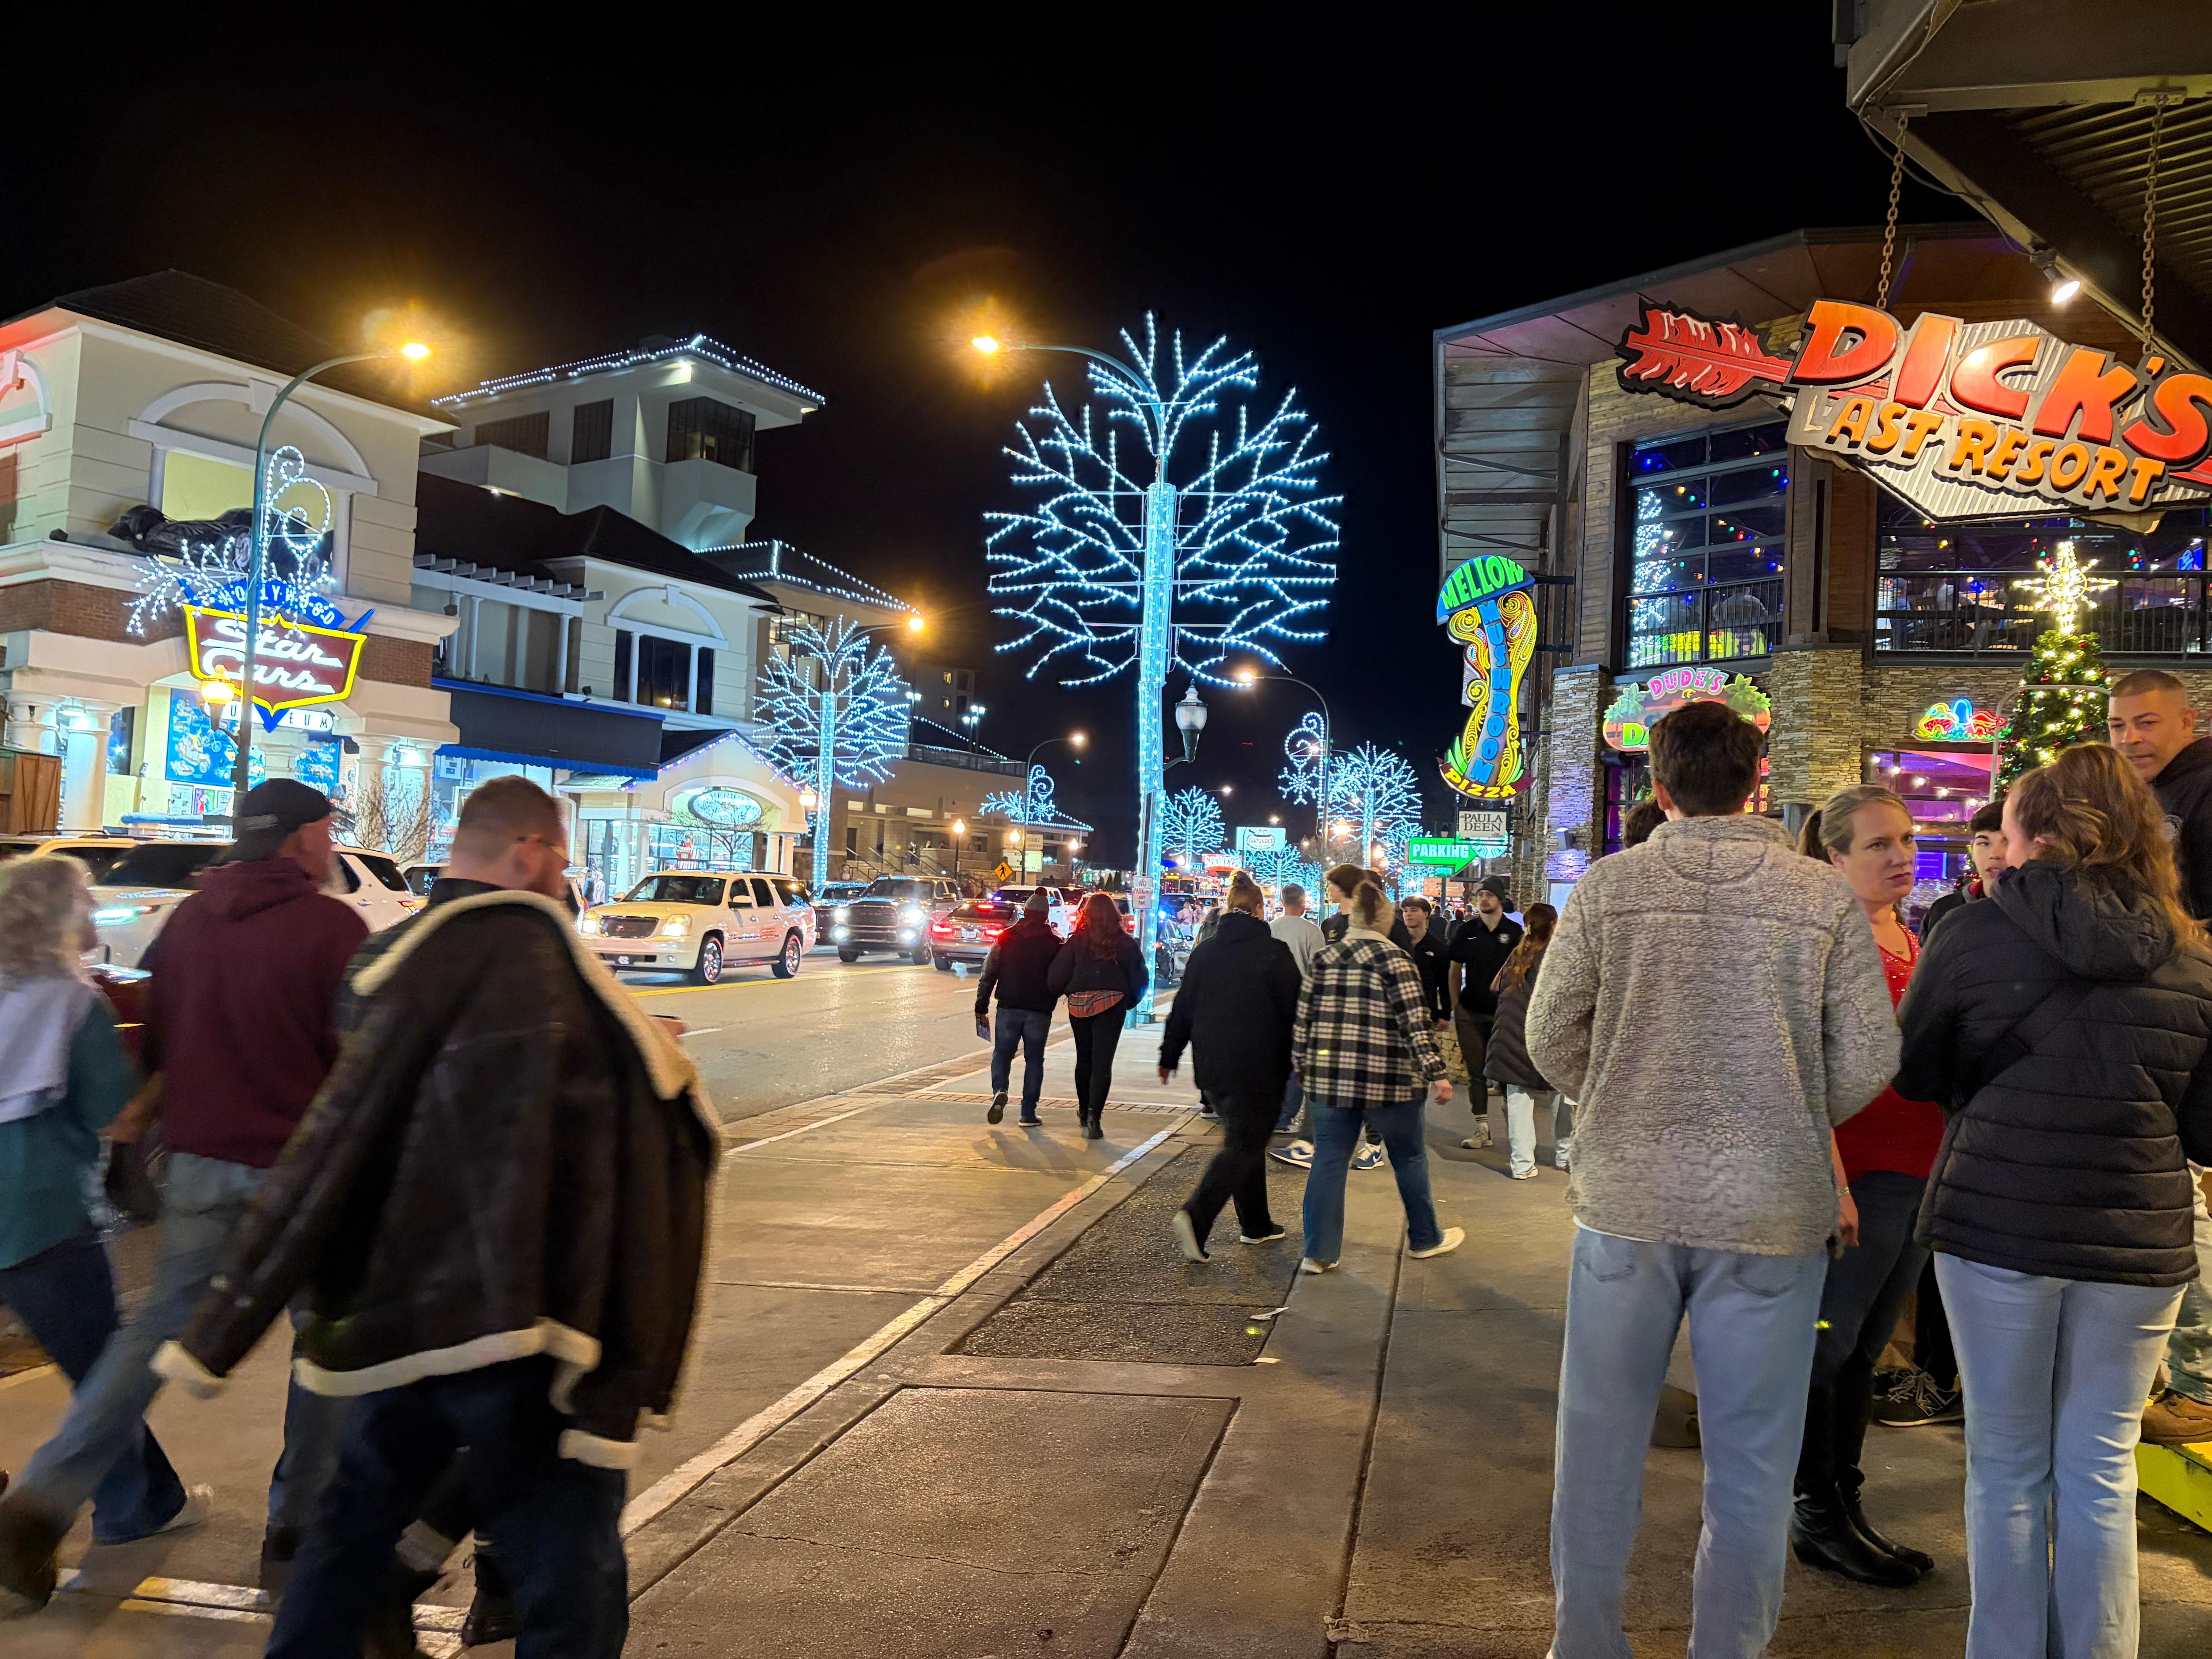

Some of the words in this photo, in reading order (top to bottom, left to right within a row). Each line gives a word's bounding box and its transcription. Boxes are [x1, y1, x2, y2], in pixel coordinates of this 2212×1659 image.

[1791, 301, 2212, 462] DICK'S
[1804, 393, 1944, 459] LAST
[1949, 418, 2166, 503] RESORT
[1441, 556, 1524, 610] MELLOW
[1471, 599, 1511, 784] MUSHROOM
[1650, 669, 1725, 698] DUDE'S
[211, 703, 327, 728] UEUM
[1445, 768, 1517, 798] PIZZA
[1463, 813, 1503, 823] PAULA
[1463, 822, 1502, 831] DEEN
[1413, 844, 1469, 858] PARKING
